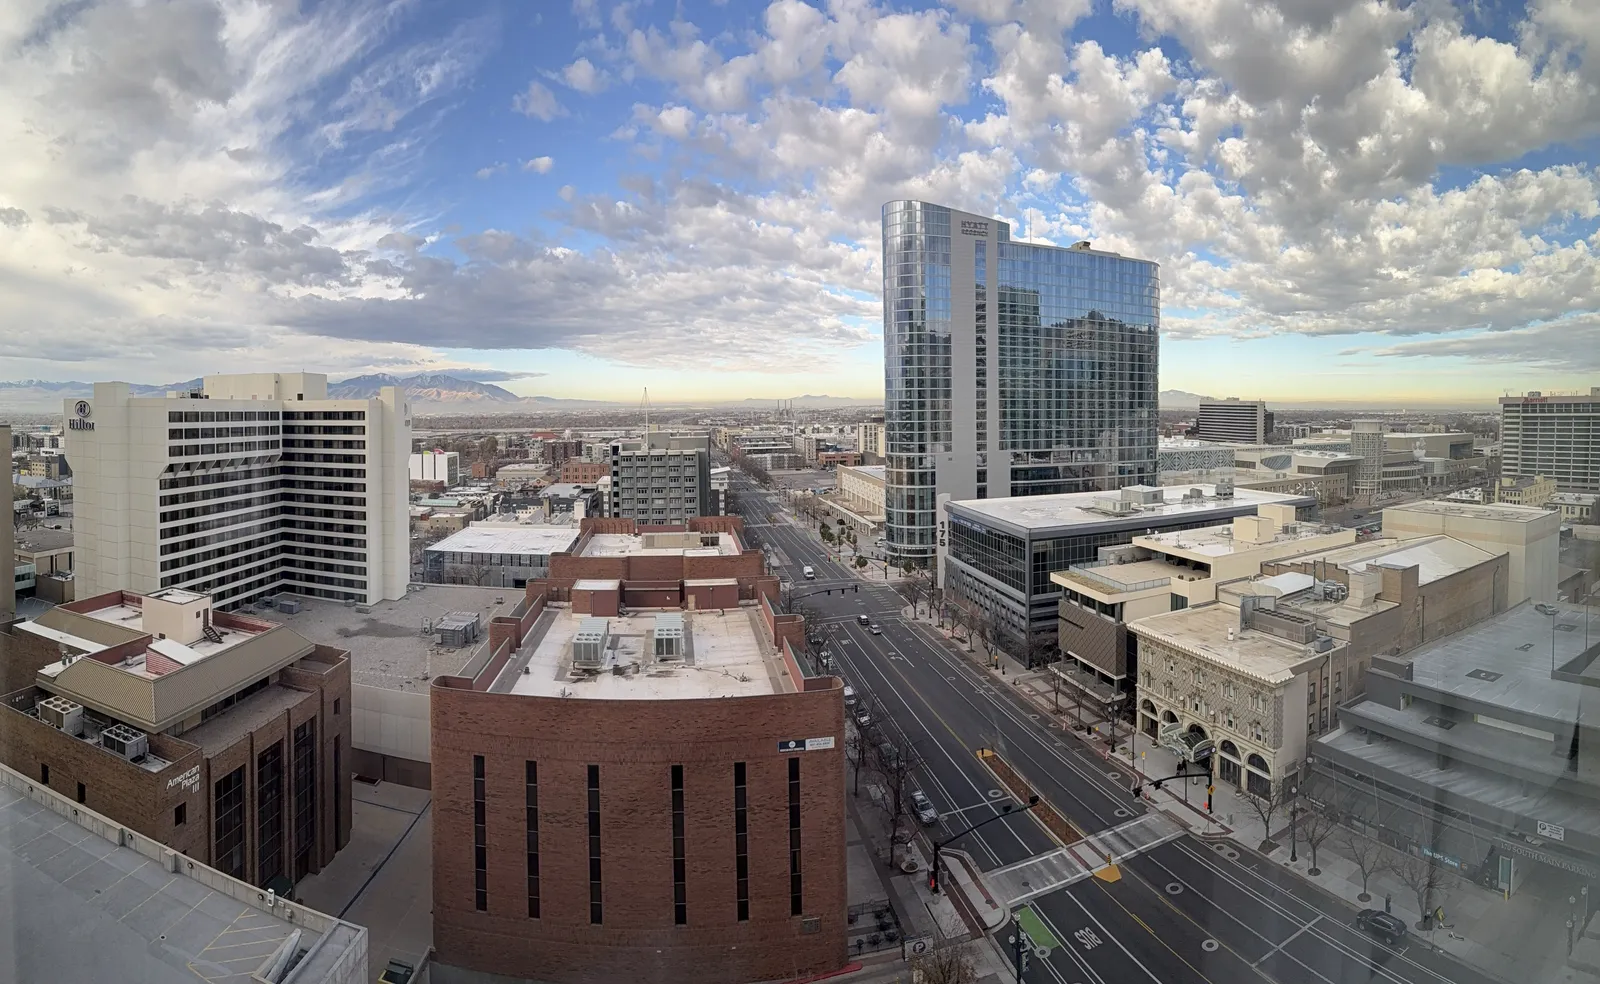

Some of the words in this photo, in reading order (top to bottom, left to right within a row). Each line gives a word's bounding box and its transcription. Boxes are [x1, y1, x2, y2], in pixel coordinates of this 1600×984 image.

[961, 220, 989, 230] HYATT
[166, 764, 200, 790] American
[181, 773, 200, 790] Plaza
[192, 781, 200, 794] III
[1433, 852, 1444, 862] UPS
[1501, 842, 1511, 851] 170
[1512, 846, 1538, 860] SOUTH
[1538, 854, 1561, 867] MAIN
[1562, 862, 1597, 879] PARKING
[1074, 926, 1103, 950] BUS
